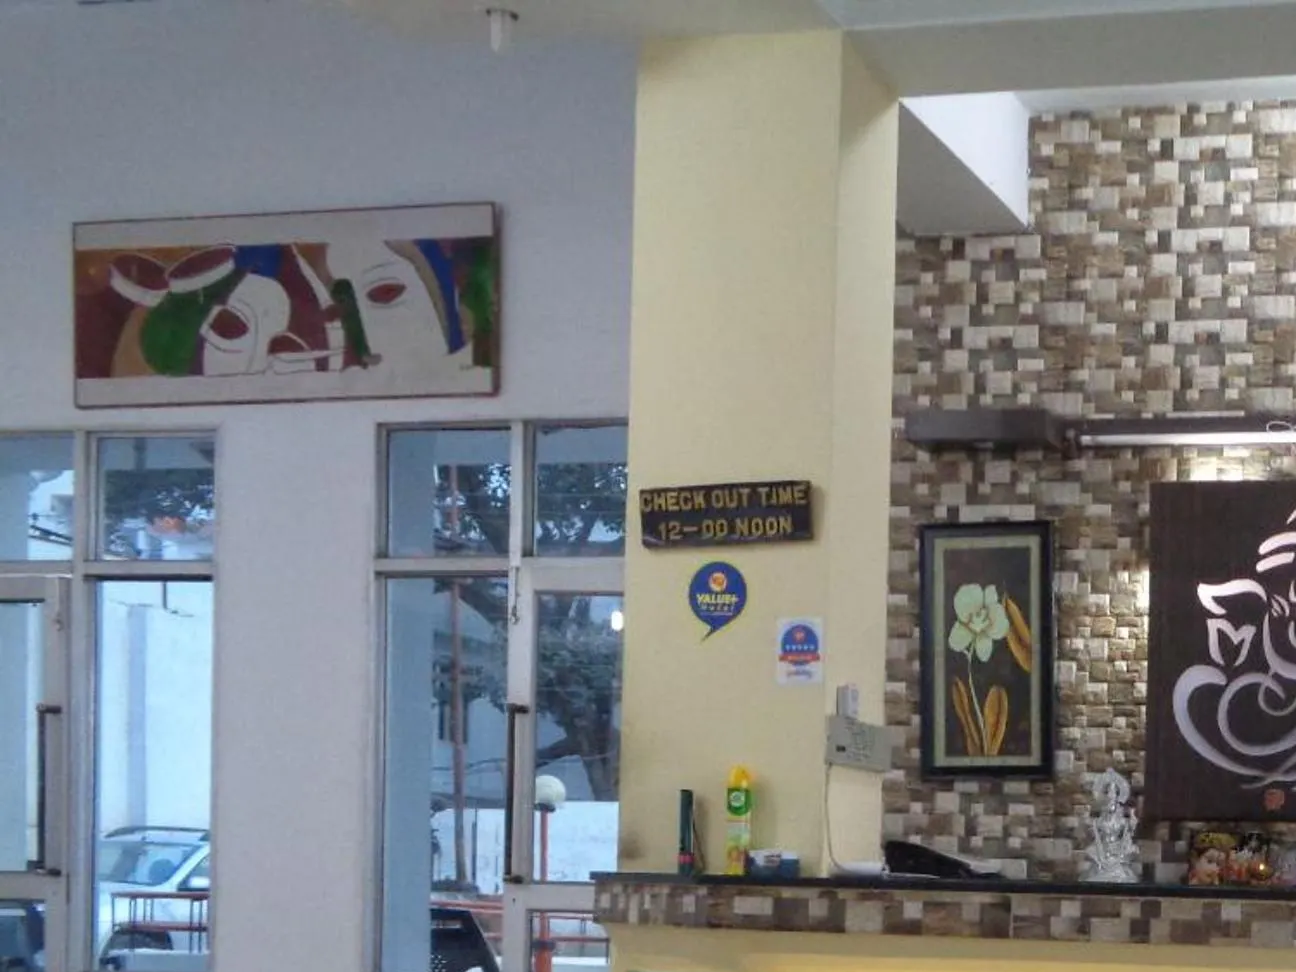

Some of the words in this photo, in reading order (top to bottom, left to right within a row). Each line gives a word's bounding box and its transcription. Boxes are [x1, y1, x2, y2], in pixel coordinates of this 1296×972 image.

[640, 490, 707, 512] CHECK
[711, 487, 751, 509] OUT
[757, 484, 808, 507] TIME
[735, 516, 793, 538] NOON
